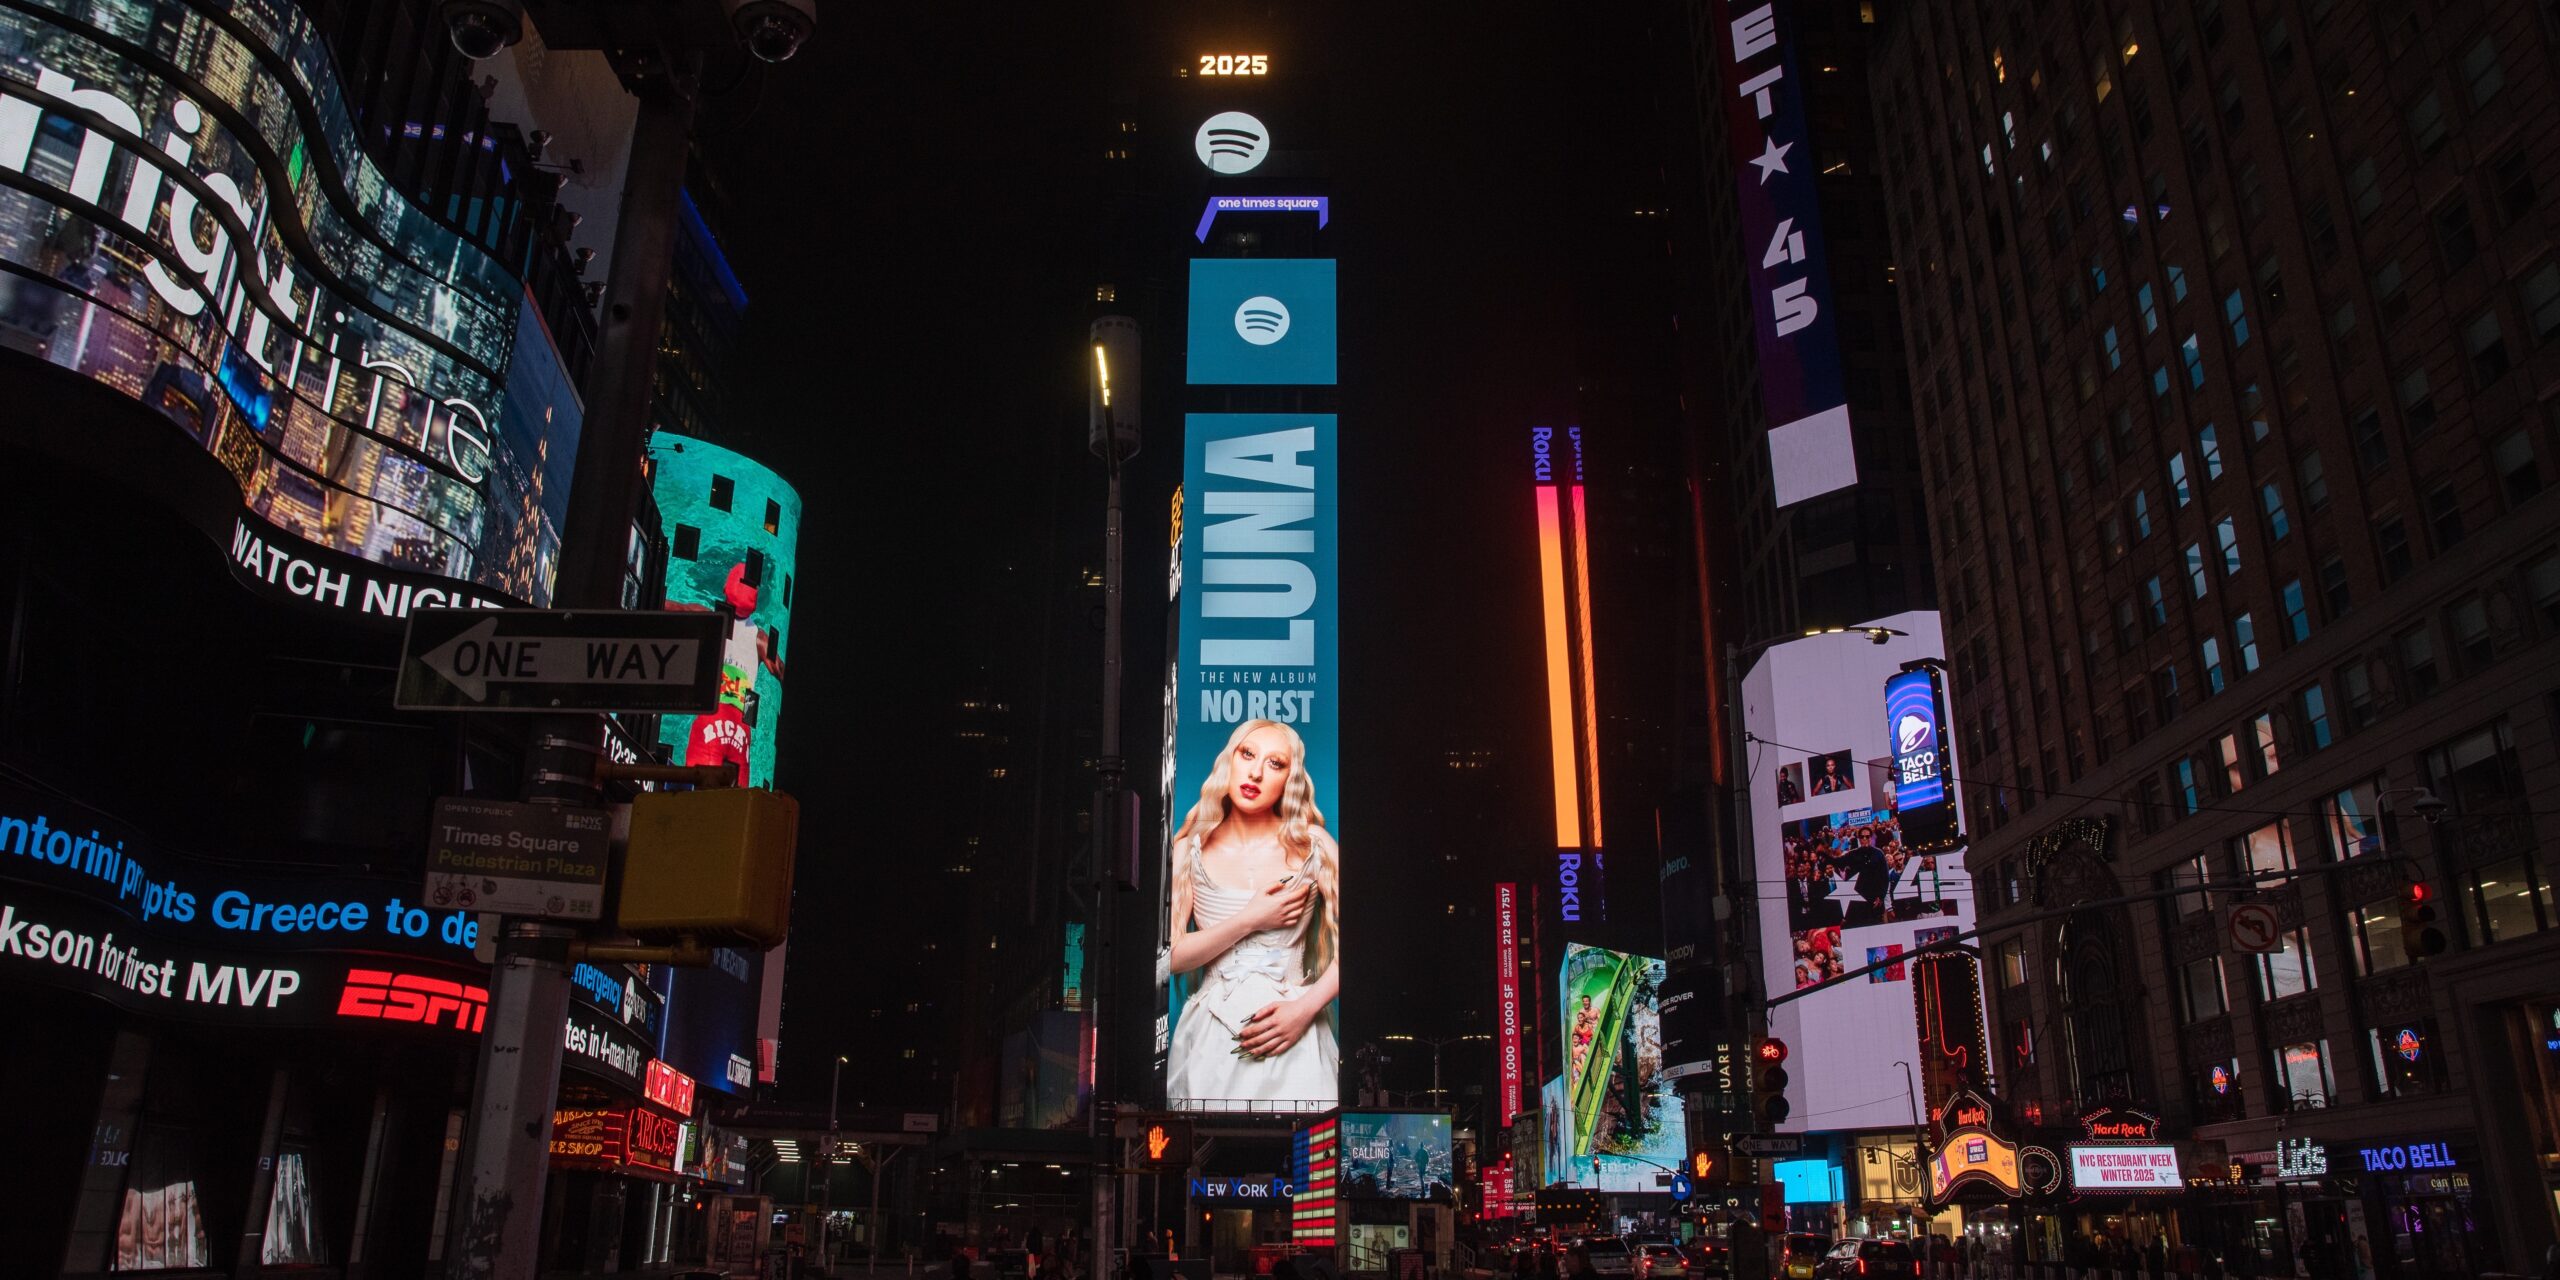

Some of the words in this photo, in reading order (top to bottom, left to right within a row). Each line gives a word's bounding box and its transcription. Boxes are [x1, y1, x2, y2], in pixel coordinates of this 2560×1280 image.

[1200, 55, 1268, 75] 2025
[1218, 198, 1242, 208] one
[1242, 197, 1276, 208] times
[1277, 197, 1319, 211] square
[1762, 216, 1818, 338] 45
[1200, 426, 1317, 666] LUNA
[231, 516, 351, 608] WATCH
[453, 640, 541, 677] ONE
[587, 642, 679, 680] WAY
[1200, 672, 1225, 683] THE
[1233, 672, 1262, 683] NEW
[1270, 672, 1317, 683] ALBUM
[1201, 689, 1243, 723] NO
[1248, 690, 1315, 723] REST
[1899, 751, 1935, 770] TACO
[1903, 768, 1936, 785] BELL
[445, 804, 469, 813] OPEN
[470, 806, 481, 814] TO
[483, 806, 513, 817] PUBLIC
[580, 815, 603, 825] NYC
[442, 825, 503, 847] Times
[507, 831, 580, 854] Square
[438, 848, 542, 873] Pedestrian
[546, 857, 597, 877] Plaza
[0, 816, 122, 885] ntorini
[211, 889, 368, 934] Greece
[386, 897, 430, 938] to
[441, 904, 477, 949] de
[1501, 888, 1511, 908] 7517
[1502, 911, 1511, 927] 841
[1503, 928, 1512, 945] 212
[0, 905, 92, 969] kson
[97, 933, 128, 979] for
[127, 942, 176, 997] first
[186, 962, 301, 1008] MVP
[571, 963, 622, 1013] mergency
[1503, 984, 1513, 998] SF
[588, 1023, 600, 1058] in
[601, 1031, 625, 1072] 4-man
[1958, 1108, 1972, 1126] Hard
[1971, 1107, 1986, 1126] Rock
[2094, 1123, 2120, 1135] Hard
[2121, 1123, 2146, 1137] Rock
[567, 1141, 603, 1155] SHOP
[1352, 1147, 1386, 1159] CALLING
[1742, 1140, 1761, 1150] ONE
[1770, 1140, 1793, 1150] WAY
[2079, 1155, 2096, 1167] NYC
[2097, 1154, 2147, 1168] RESTAURANT
[2149, 1153, 2173, 1167] WEEK
[2278, 1137, 2327, 1177] Lids
[2360, 1146, 2406, 1172] TACO
[2408, 1142, 2456, 1169] BELL
[2101, 1169, 2132, 1182] WINTER
[2134, 1169, 2155, 1182] 2025
[2430, 1174, 2469, 1188] canina
